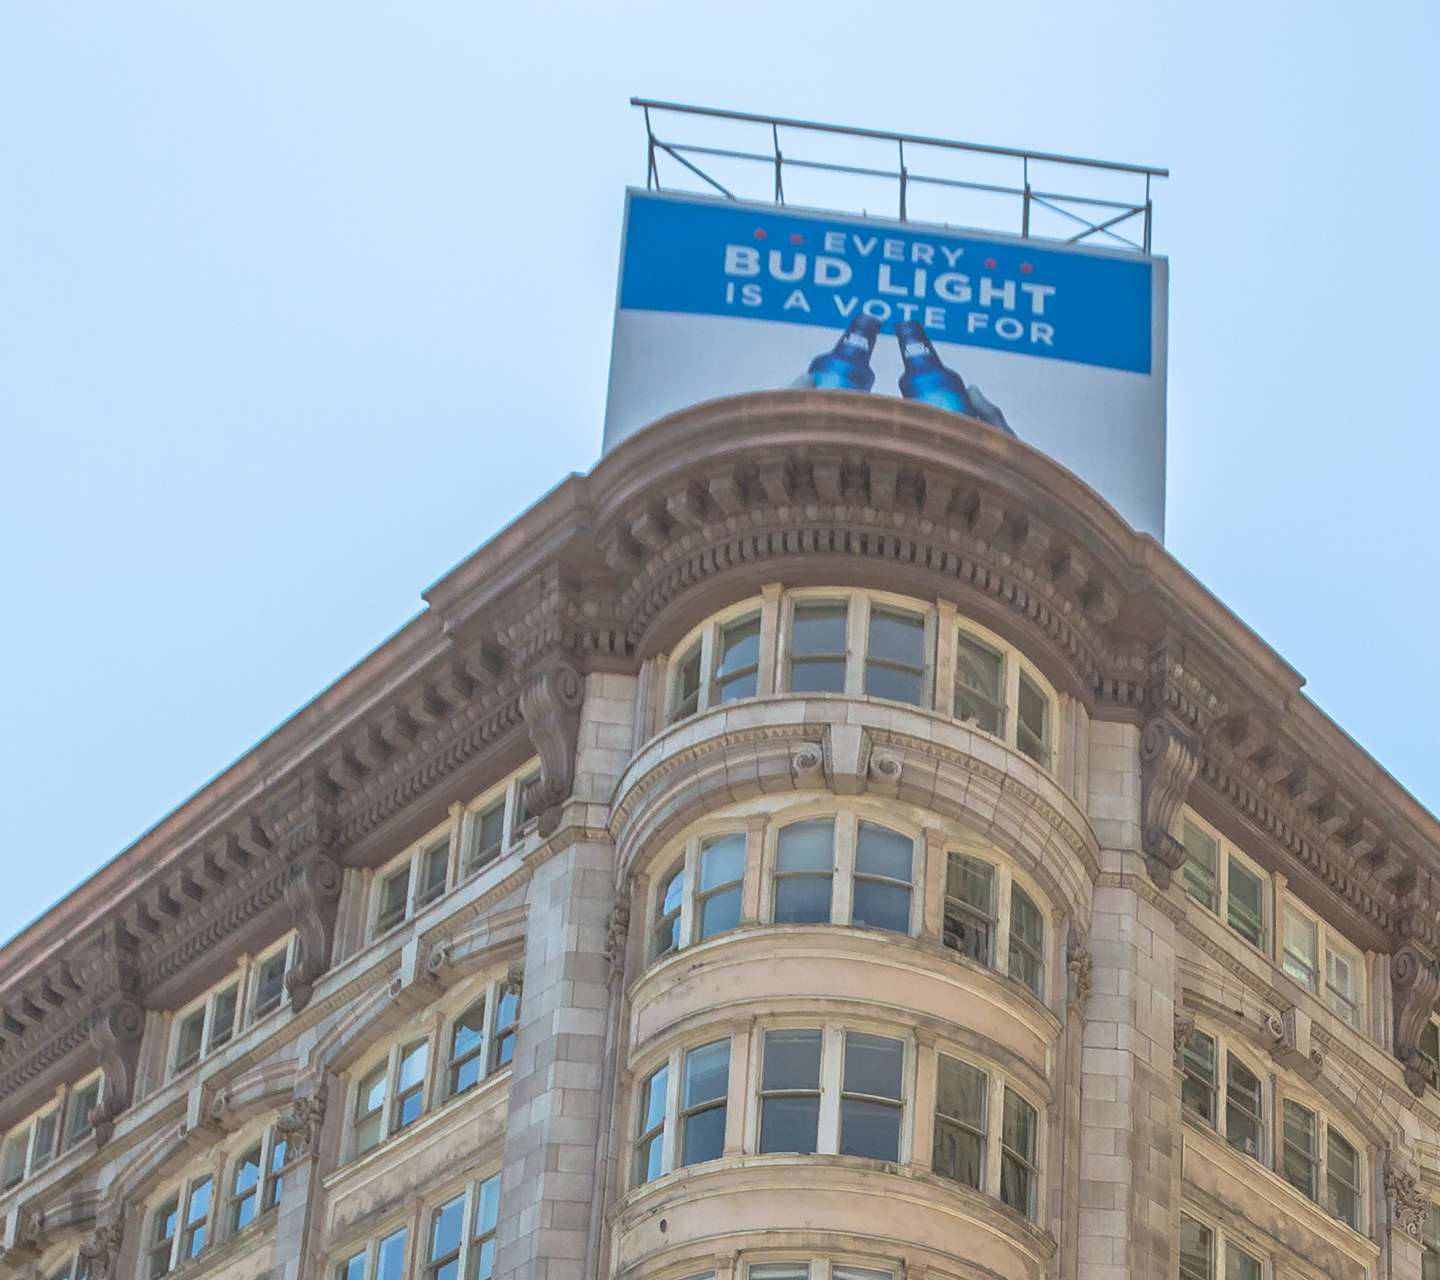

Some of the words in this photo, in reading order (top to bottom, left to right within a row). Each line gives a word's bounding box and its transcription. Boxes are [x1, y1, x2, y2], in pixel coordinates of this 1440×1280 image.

[723, 244, 853, 287] BUD
[877, 262, 1057, 314] LIGHT
[824, 231, 965, 268] EVERY
[725, 281, 763, 307] IS
[783, 288, 812, 313] A
[833, 294, 947, 331] VOTE
[967, 312, 1056, 347] FOR
